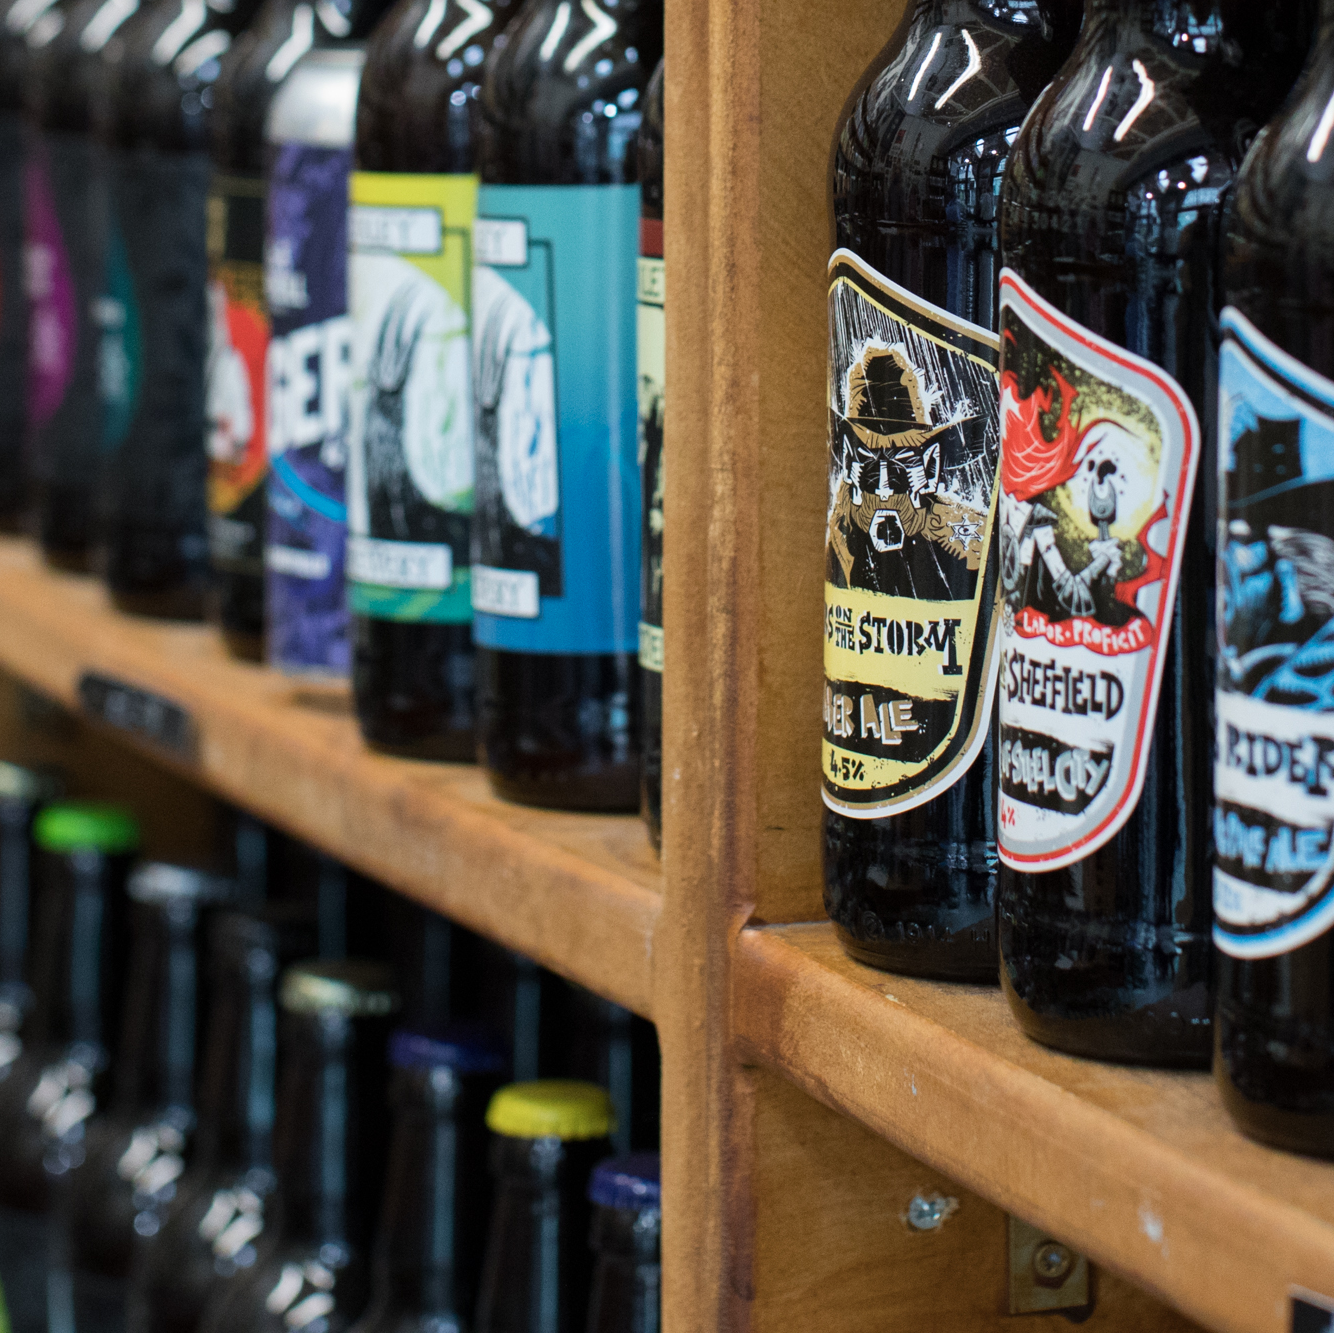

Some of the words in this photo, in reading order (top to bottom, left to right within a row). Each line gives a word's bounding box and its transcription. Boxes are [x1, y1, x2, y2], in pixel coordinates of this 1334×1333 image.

[835, 604, 853, 623] ON
[1022, 611, 1065, 644] LABOR
[1072, 615, 1145, 654] PROFICIT
[835, 625, 856, 651] THE
[857, 610, 964, 676] STORM
[1007, 647, 1125, 721] SHEFFIELD
[860, 692, 919, 746] ALE
[830, 749, 866, 781] 4.5%
[1011, 739, 1057, 794] STEEL
[1054, 748, 1110, 802] CITY
